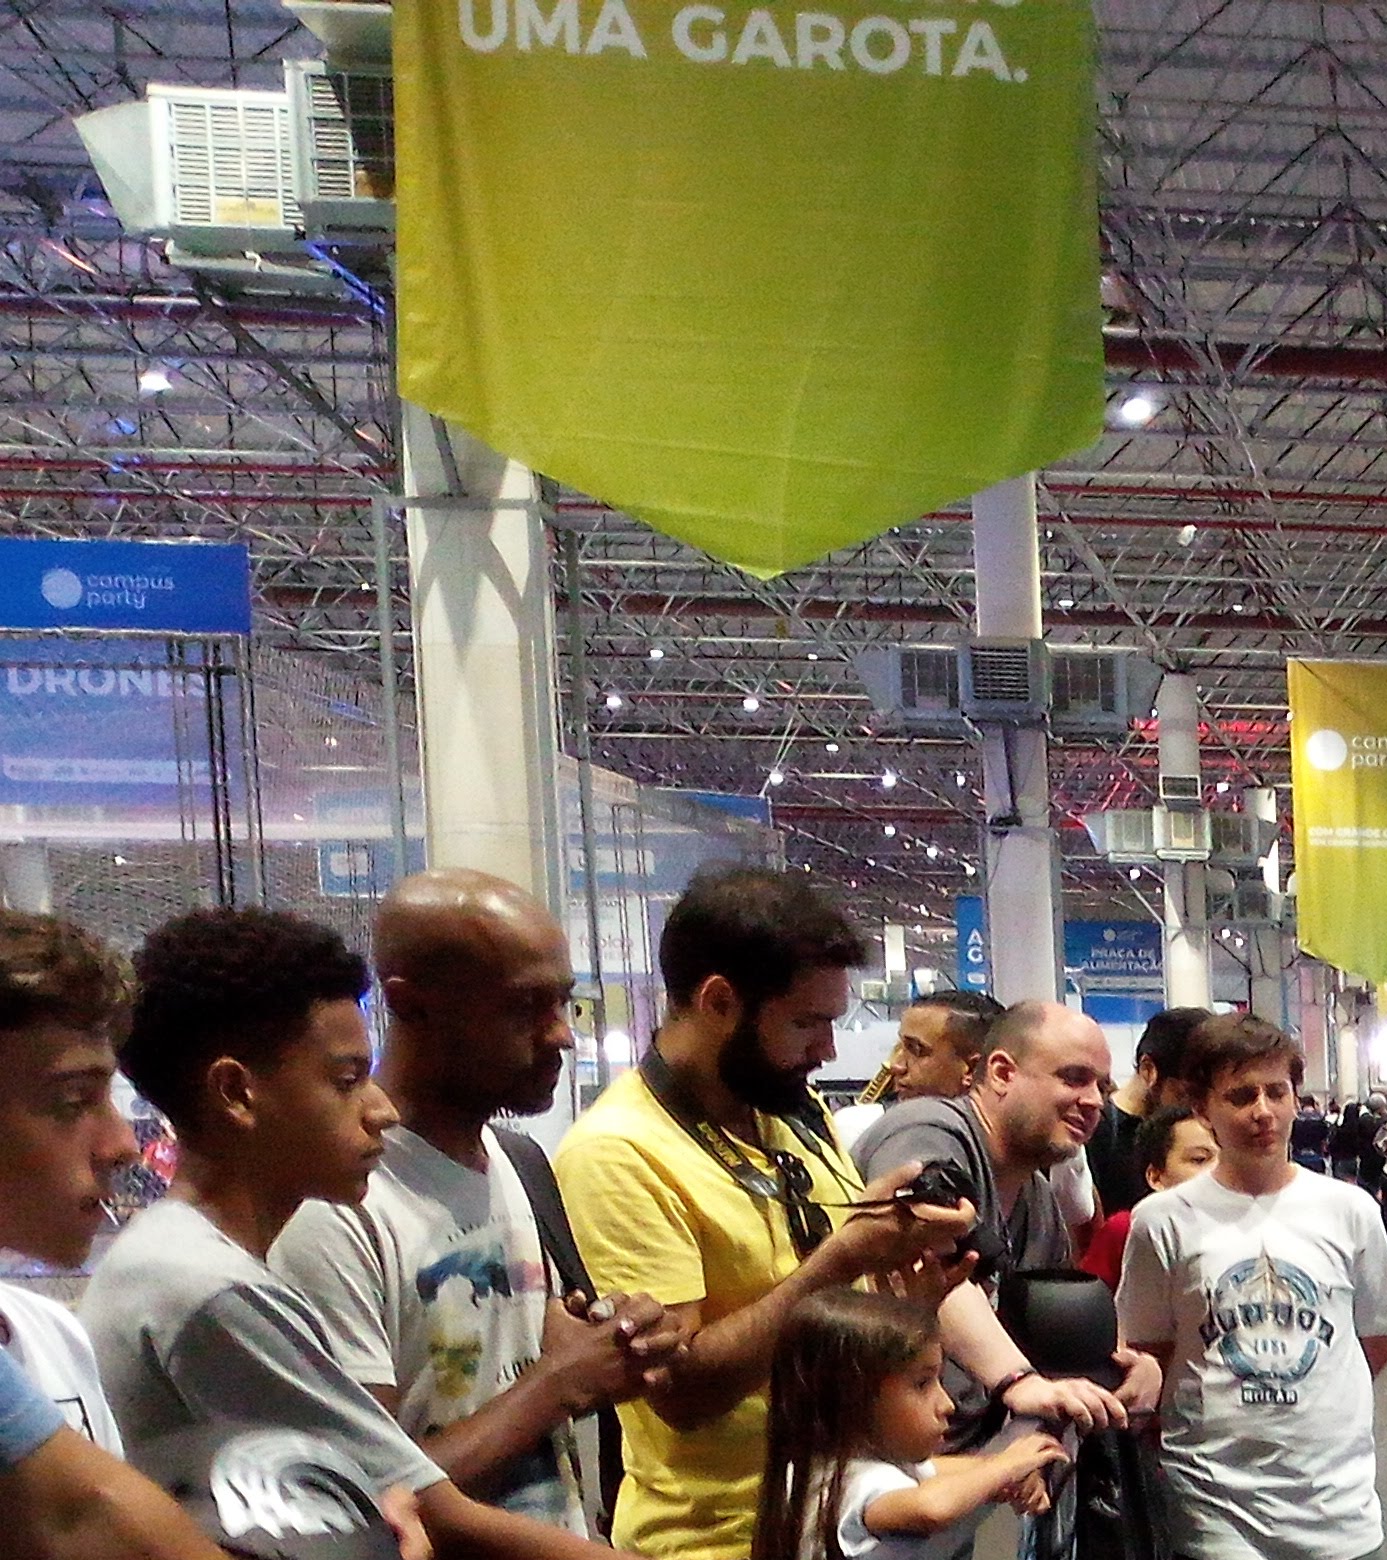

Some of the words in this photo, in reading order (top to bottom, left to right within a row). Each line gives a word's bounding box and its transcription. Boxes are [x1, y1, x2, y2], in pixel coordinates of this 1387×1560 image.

[457, 0, 648, 57] UMA
[671, 8, 1029, 83] GAROTA.
[86, 573, 174, 592] campus
[86, 588, 146, 608] party
